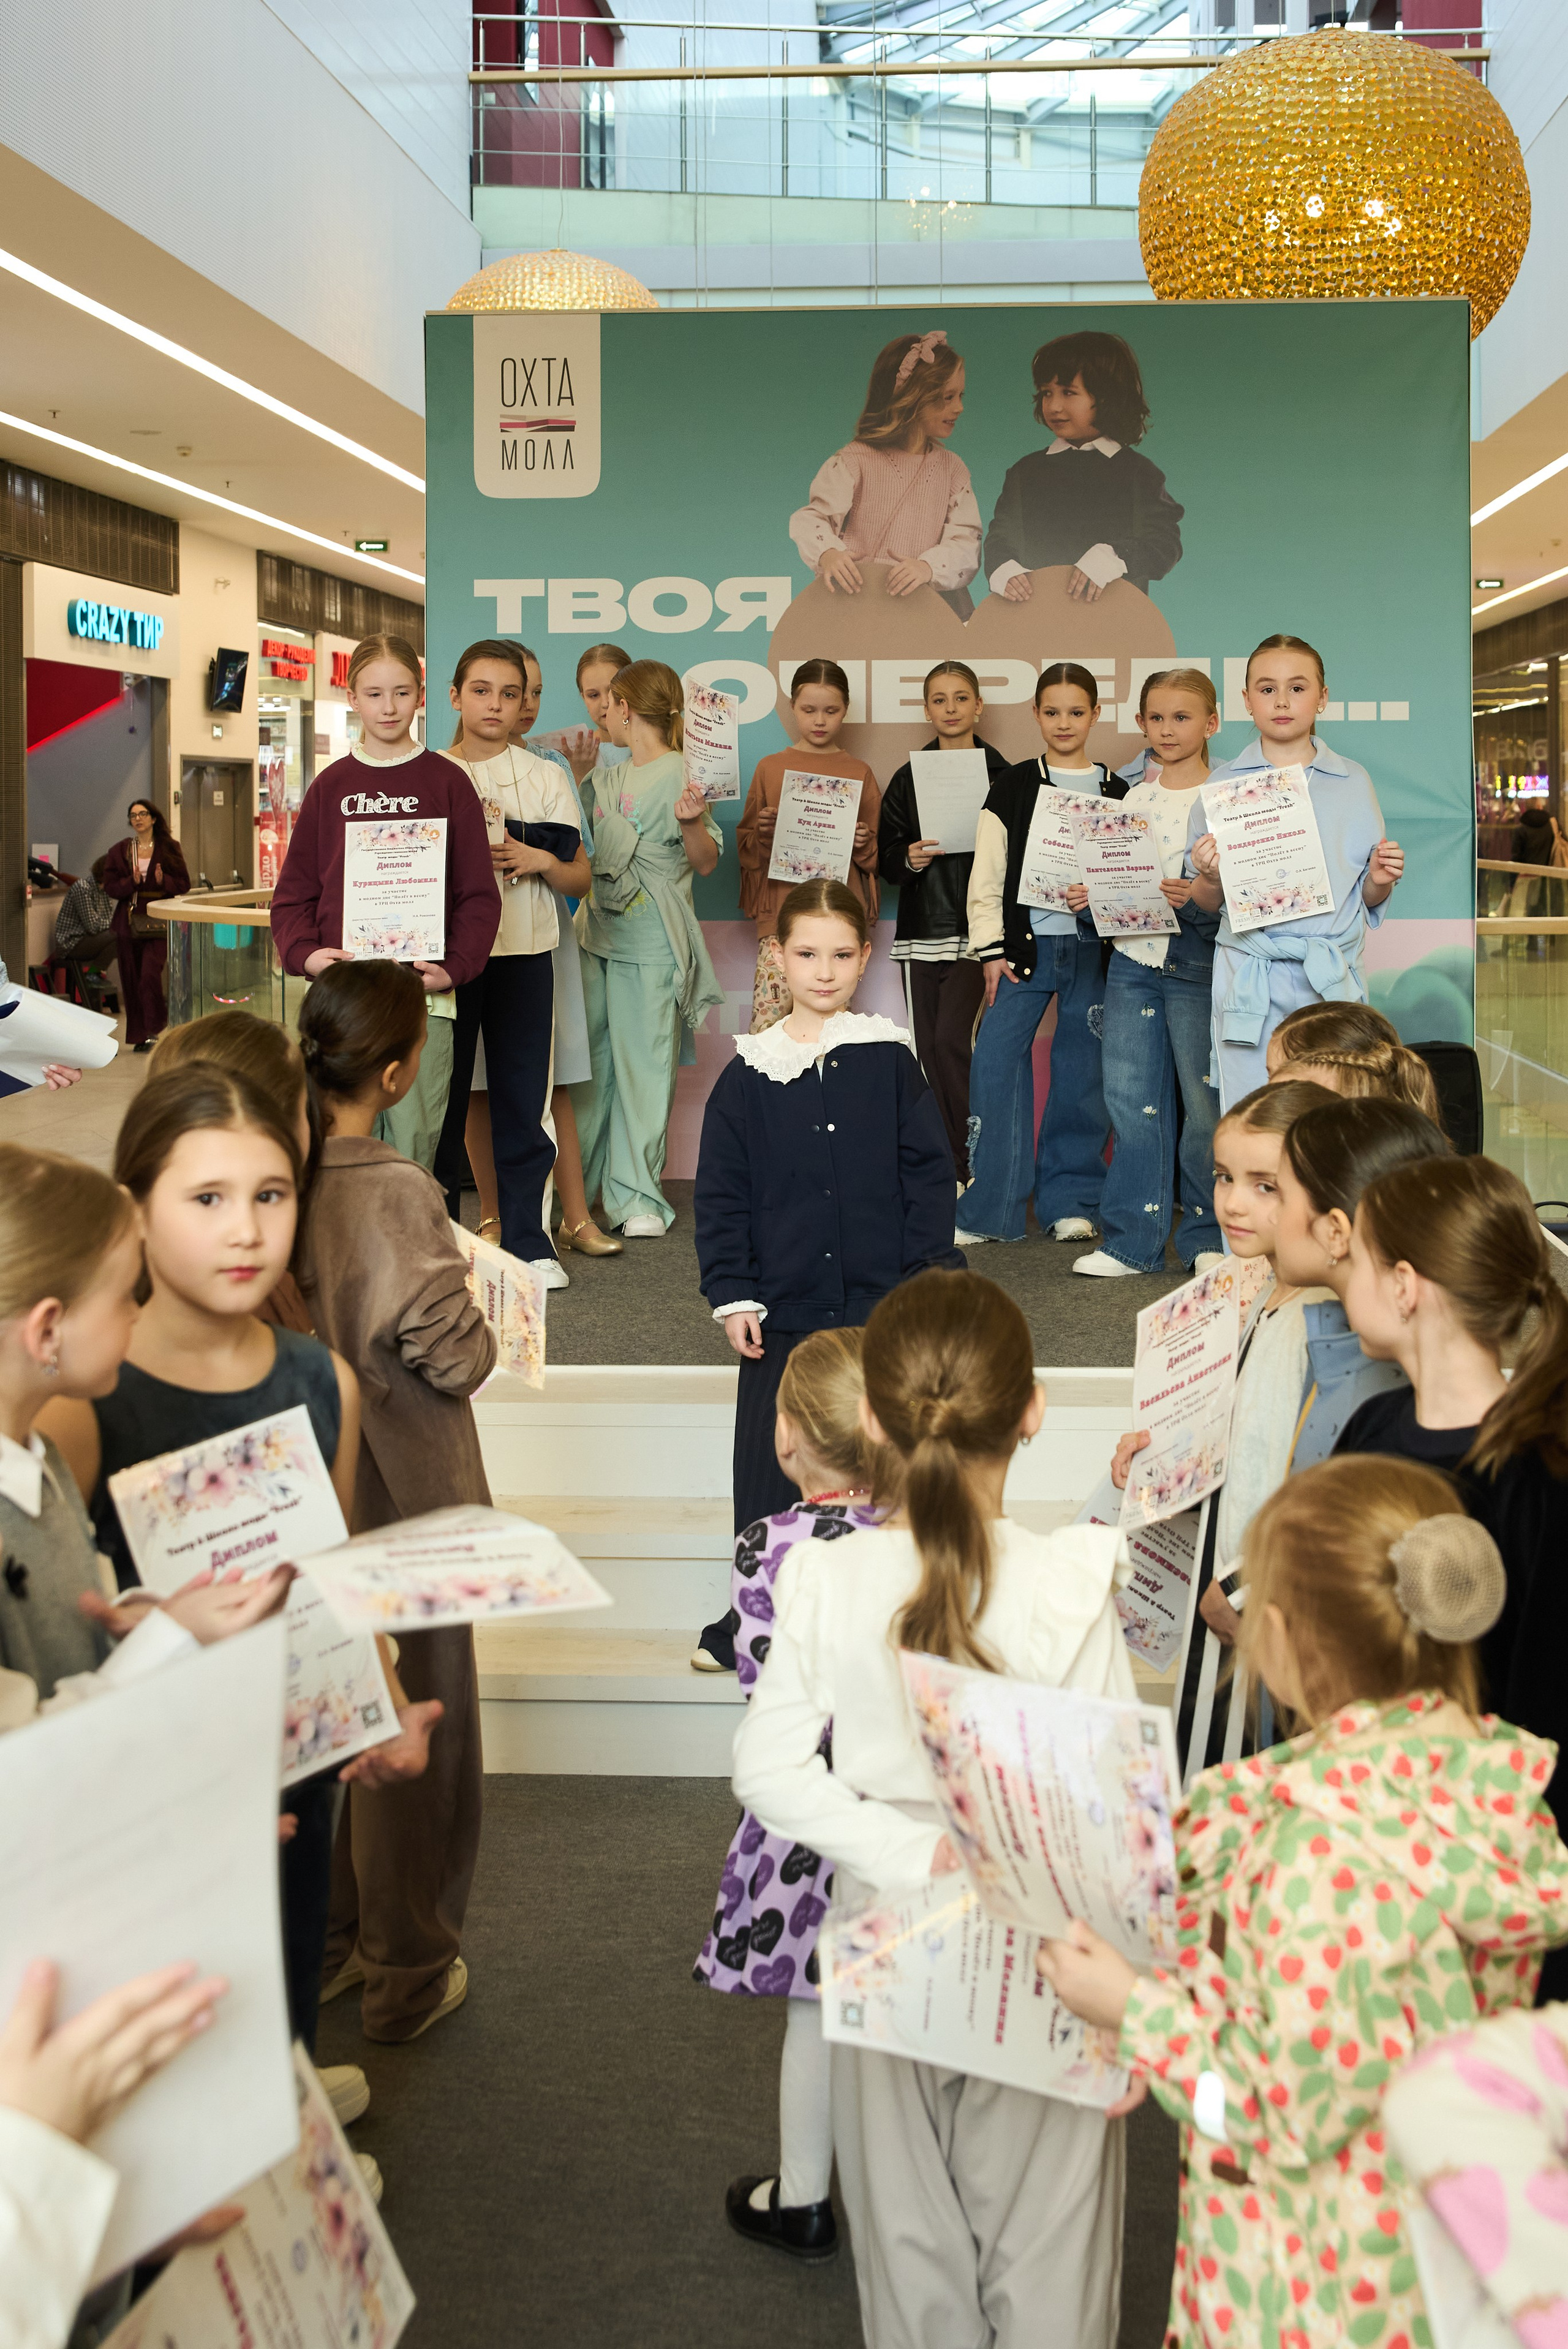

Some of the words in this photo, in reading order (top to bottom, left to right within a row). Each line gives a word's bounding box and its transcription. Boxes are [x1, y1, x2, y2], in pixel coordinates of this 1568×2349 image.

[500, 358, 575, 407] ОХТА
[502, 439, 574, 470] МОЛЛ
[473, 576, 791, 634] ТВОЯ
[76, 598, 130, 644] CRAZY
[134, 611, 164, 650] ТИР
[693, 719, 712, 731] Диплом
[341, 791, 419, 816] Chère
[804, 805, 832, 815] Диплом
[812, 821, 835, 829] Арина
[1243, 815, 1281, 830] Диплом
[1042, 838, 1074, 850] Соболев
[1227, 835, 1275, 851] Бондаренко
[1276, 828, 1306, 839] Николь
[377, 861, 412, 870] Диплом
[1101, 850, 1131, 859] Диплом
[487, 1280, 496, 1322] Диплом
[1166, 1340, 1205, 1372] Диплом
[1139, 1379, 1185, 1411] Васильева
[1187, 1352, 1231, 1386] Анастасия
[211, 1530, 278, 1569] Диплом
[1134, 1570, 1163, 1593] Дип
[1156, 1603, 1175, 1621] Театр
